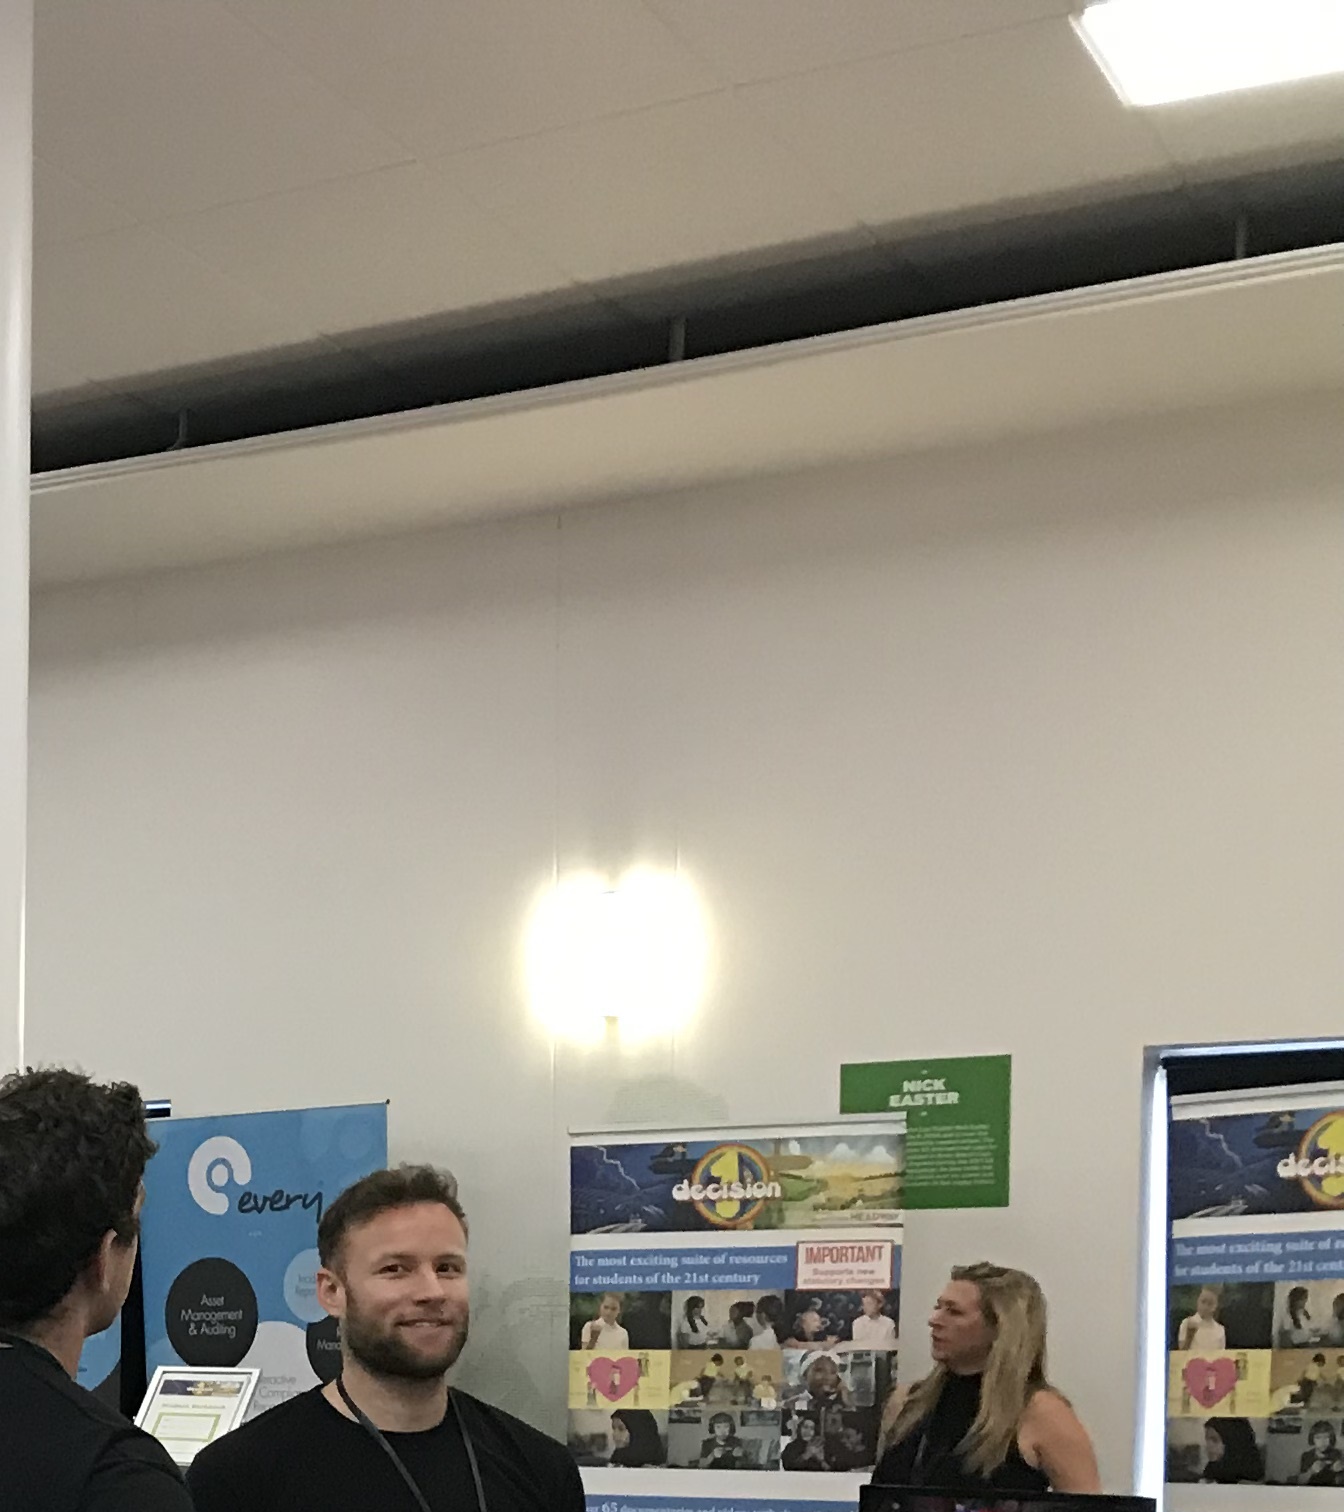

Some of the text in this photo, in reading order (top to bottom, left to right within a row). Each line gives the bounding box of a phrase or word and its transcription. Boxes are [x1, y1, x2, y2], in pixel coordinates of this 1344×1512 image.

[903, 1079, 946, 1092] NICK
[890, 1092, 959, 1107] EASTER
[672, 1179, 781, 1200] decision
[238, 1189, 323, 1224] every
[1196, 1243, 1226, 1255] most
[1229, 1241, 1283, 1256] exciting
[1285, 1240, 1315, 1251] suite
[1318, 1238, 1332, 1250] of
[575, 1253, 788, 1268] The most exciting suite of resources
[803, 1245, 884, 1265] IMPORTANT
[1190, 1262, 1243, 1276] students
[1245, 1261, 1261, 1275] of
[1263, 1261, 1286, 1274] the
[1288, 1260, 1312, 1273] 21st
[575, 1272, 761, 1286] for students of the 21st century
[200, 1294, 225, 1306] Asset
[180, 1309, 243, 1324] Management
[188, 1323, 237, 1339] & Auditing
